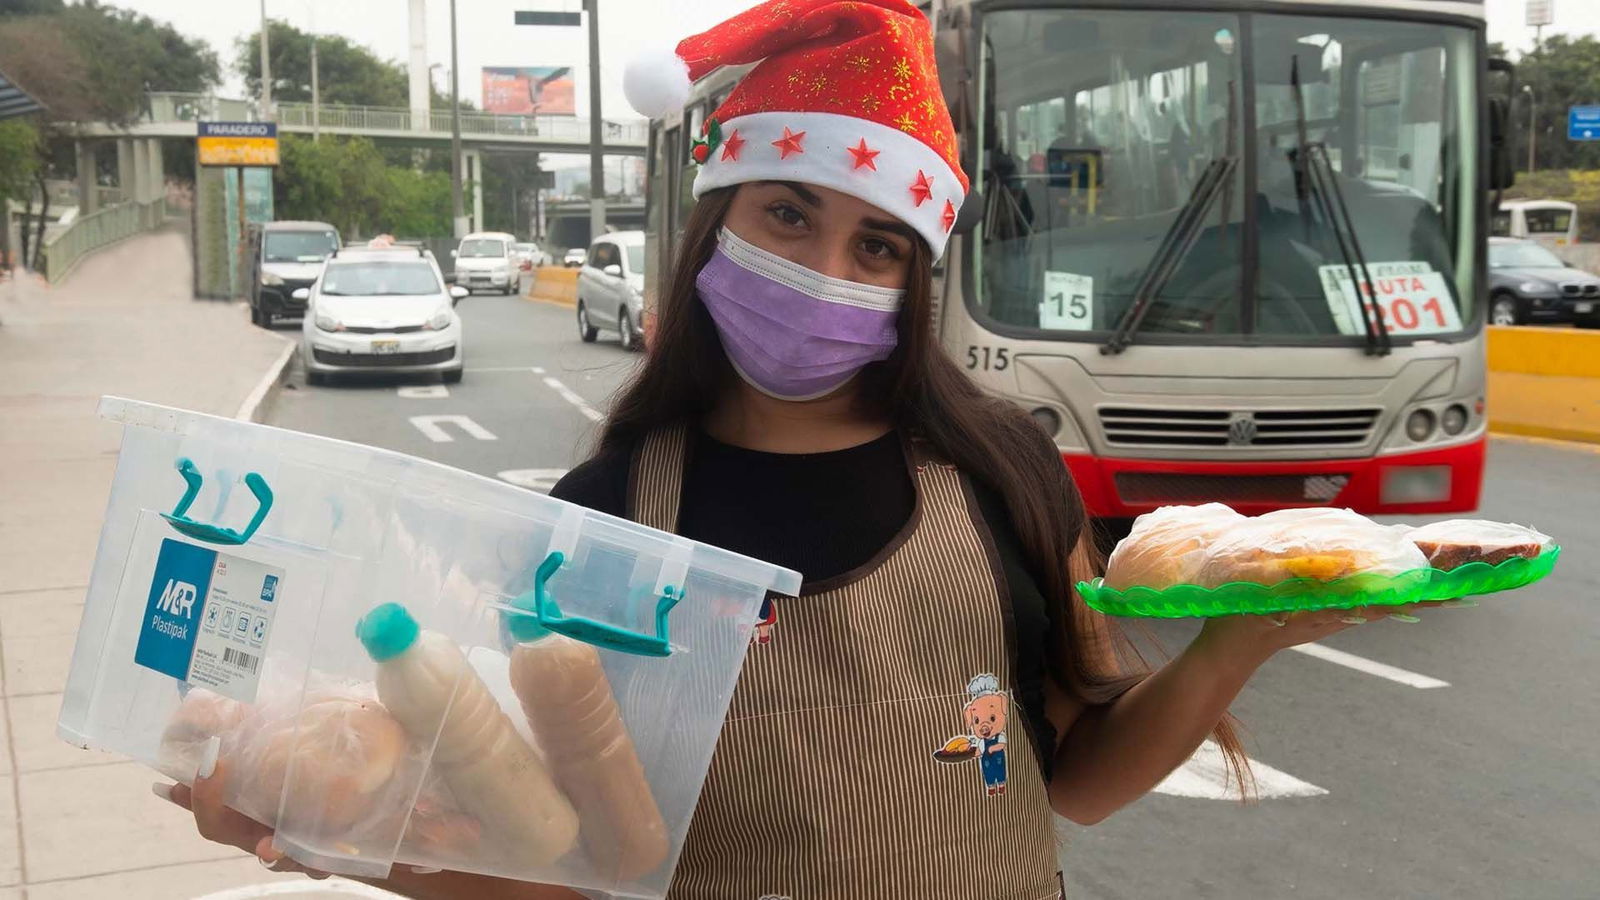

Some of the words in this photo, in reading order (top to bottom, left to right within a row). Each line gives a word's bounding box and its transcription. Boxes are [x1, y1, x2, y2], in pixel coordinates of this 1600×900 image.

[207, 124, 268, 135] PARADERO
[1050, 292, 1087, 319] 15
[1364, 297, 1446, 337] 201
[966, 345, 1008, 371] 515
[156, 578, 197, 619] M&R
[151, 614, 189, 640] Plastipak
